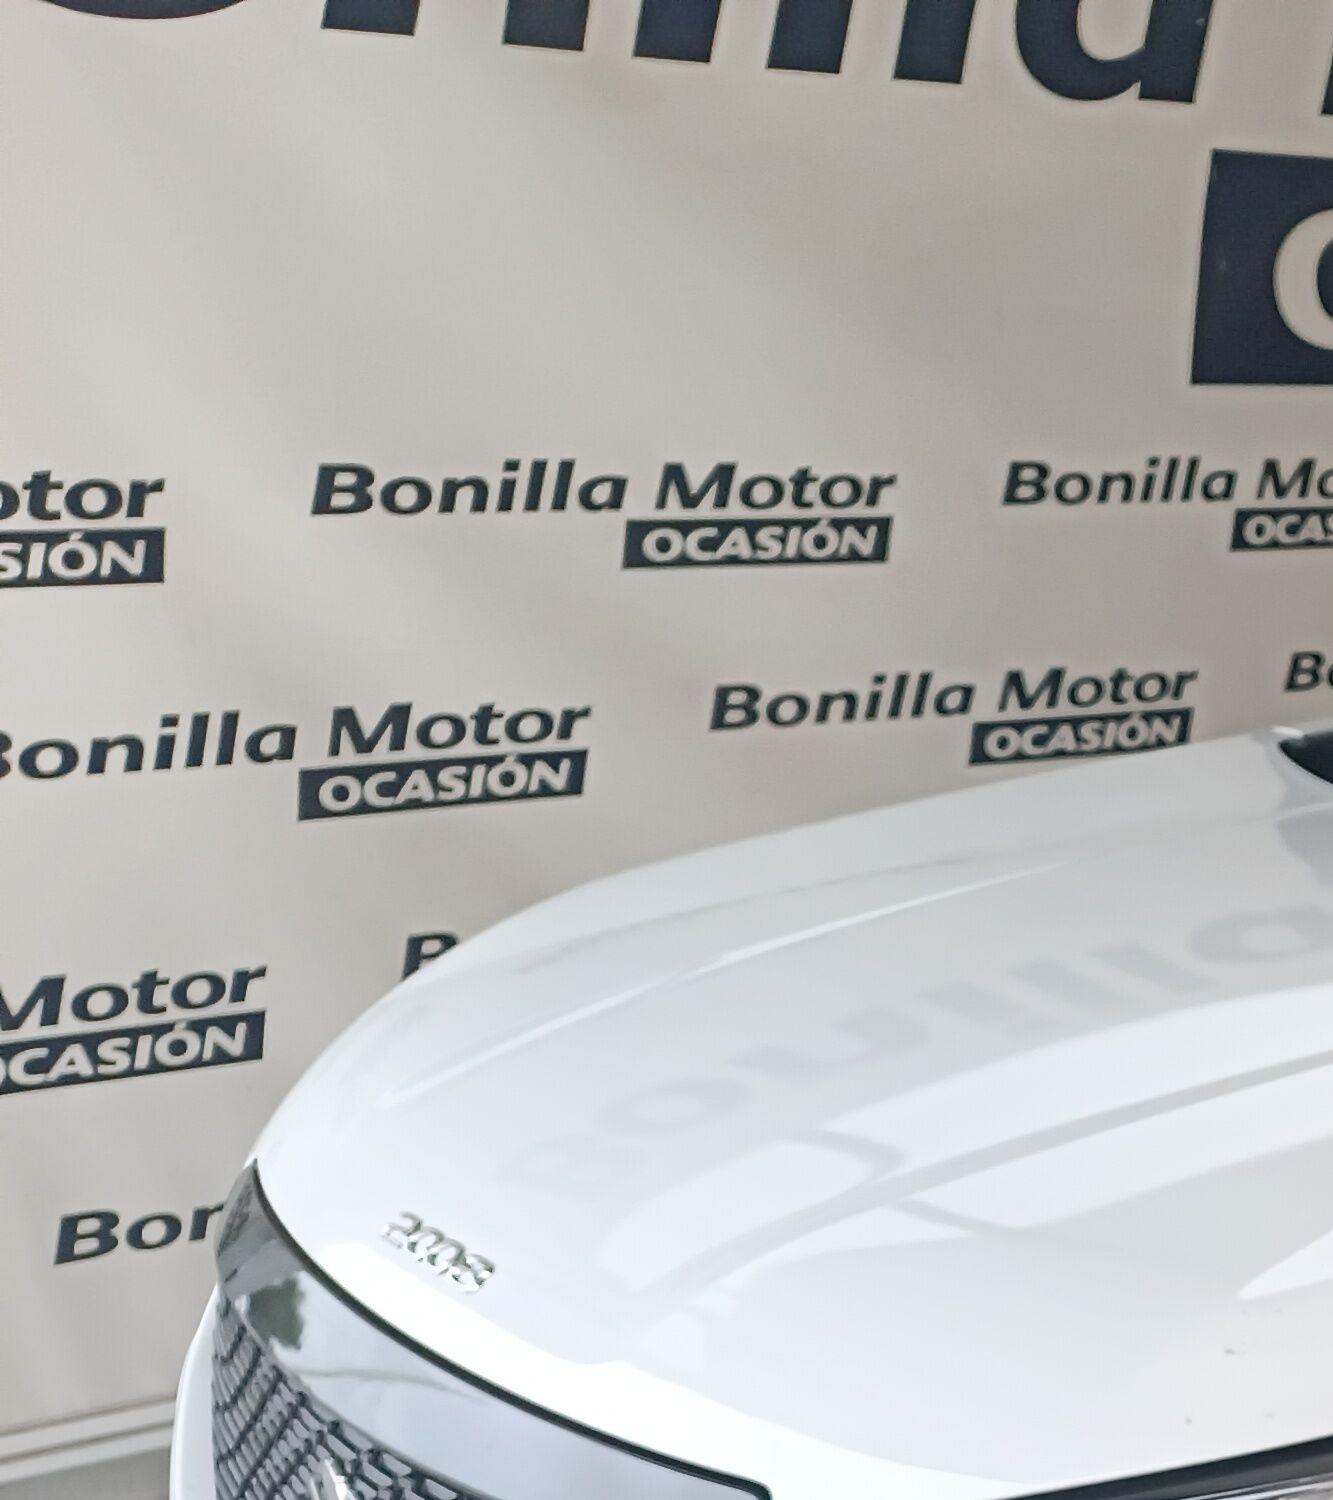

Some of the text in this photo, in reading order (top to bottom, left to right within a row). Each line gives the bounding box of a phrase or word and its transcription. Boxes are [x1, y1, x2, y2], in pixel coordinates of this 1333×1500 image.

[311, 459, 897, 515] Bonilla Motor
[1003, 457, 1237, 505] Bonilla
[642, 521, 877, 562] OCASIÓN
[710, 668, 1198, 732] Bonilla Motor
[0, 702, 591, 780] onilla Motor
[983, 711, 1182, 758] OCASIÓN
[318, 754, 571, 812] OCASIÓN
[0, 1021, 247, 1089] CASIÓN
